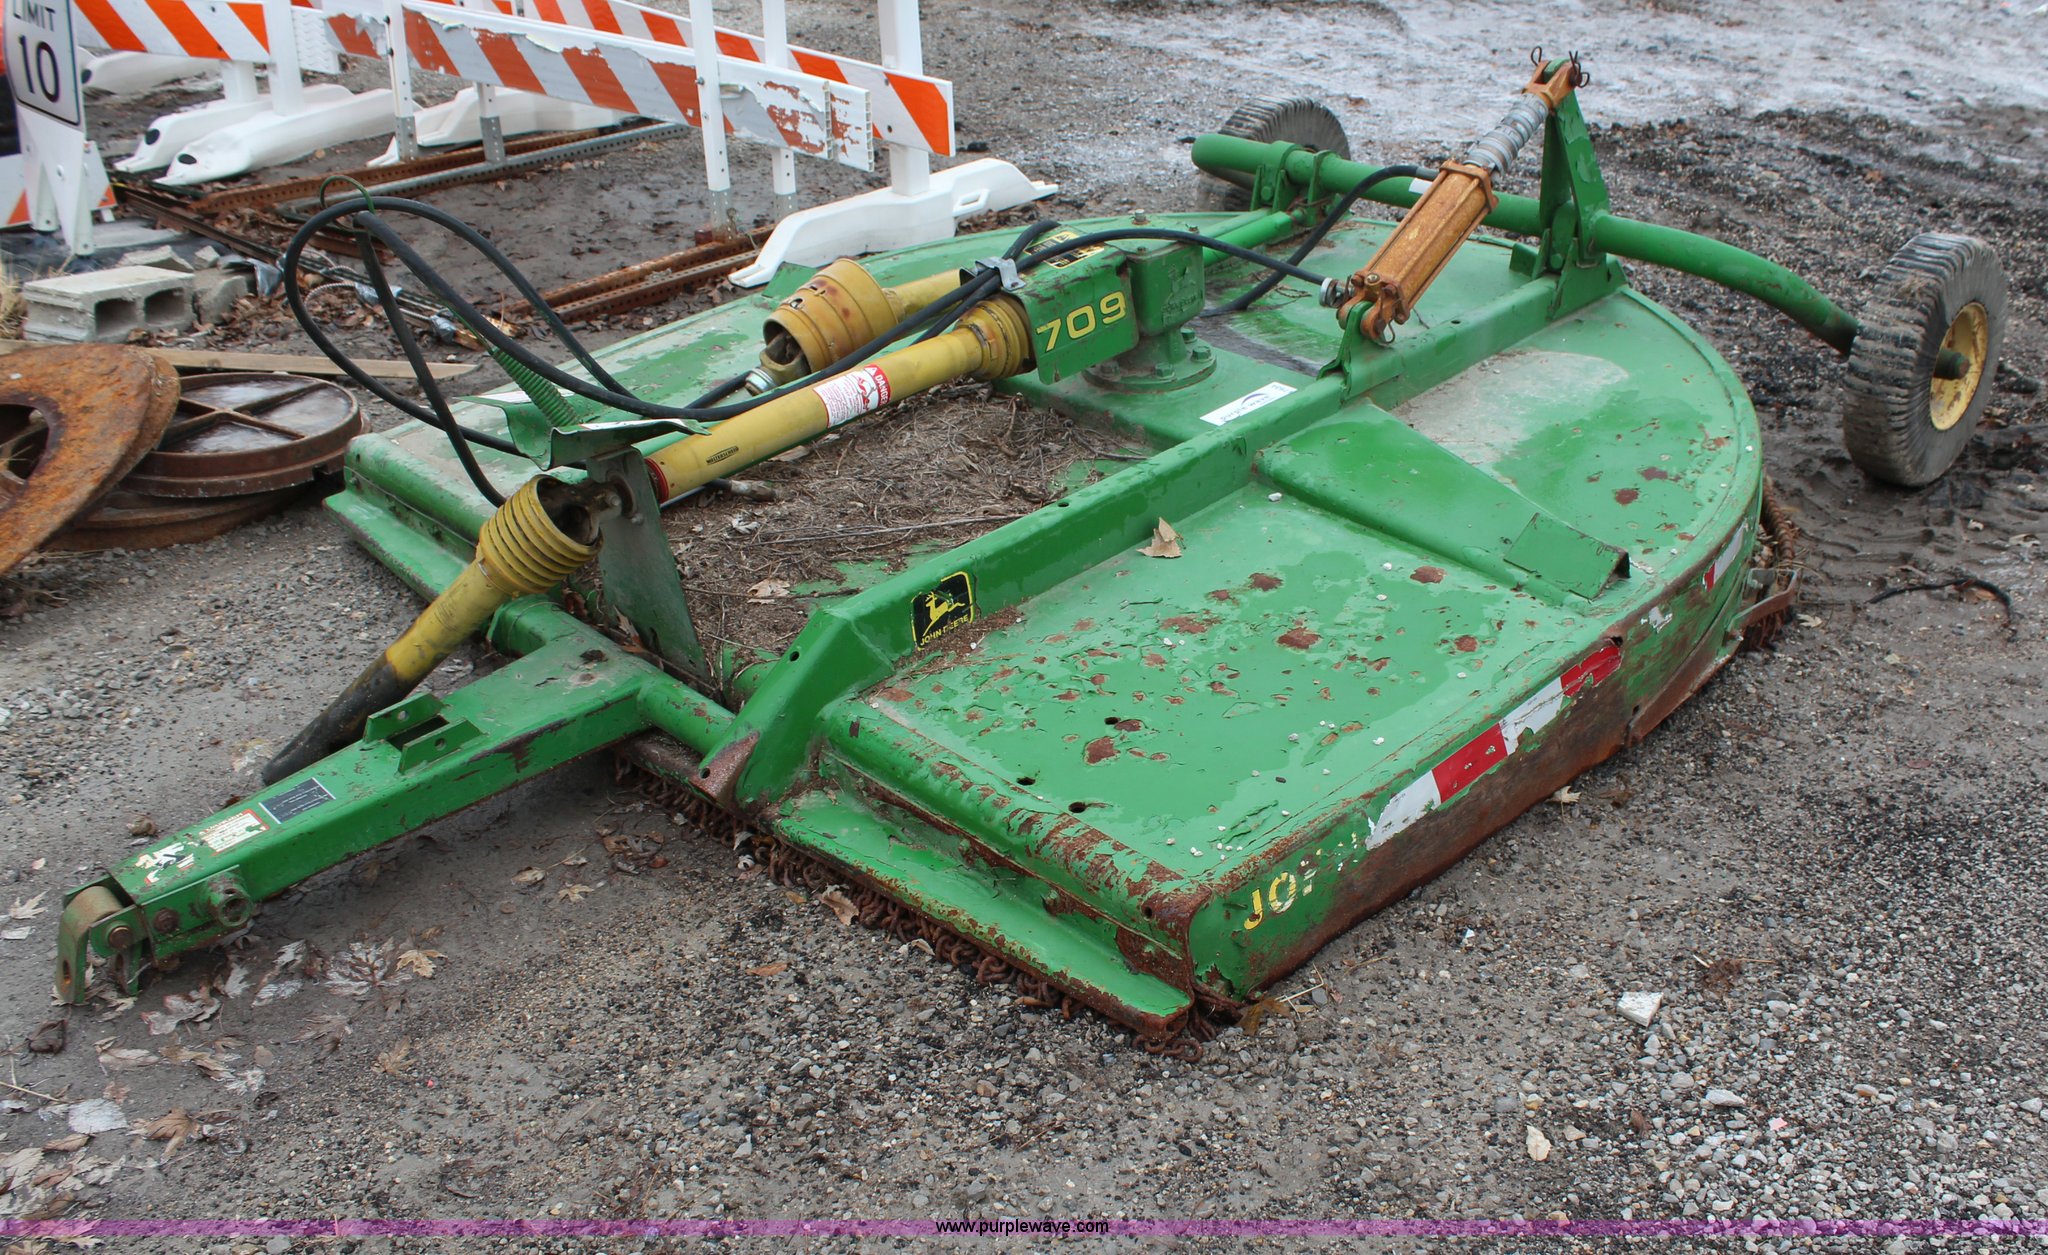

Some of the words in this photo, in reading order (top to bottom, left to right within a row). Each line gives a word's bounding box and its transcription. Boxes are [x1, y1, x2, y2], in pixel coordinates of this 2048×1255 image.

[13, 0, 56, 31] LIMIT
[18, 35, 59, 103] 10
[1035, 291, 1126, 352] 709
